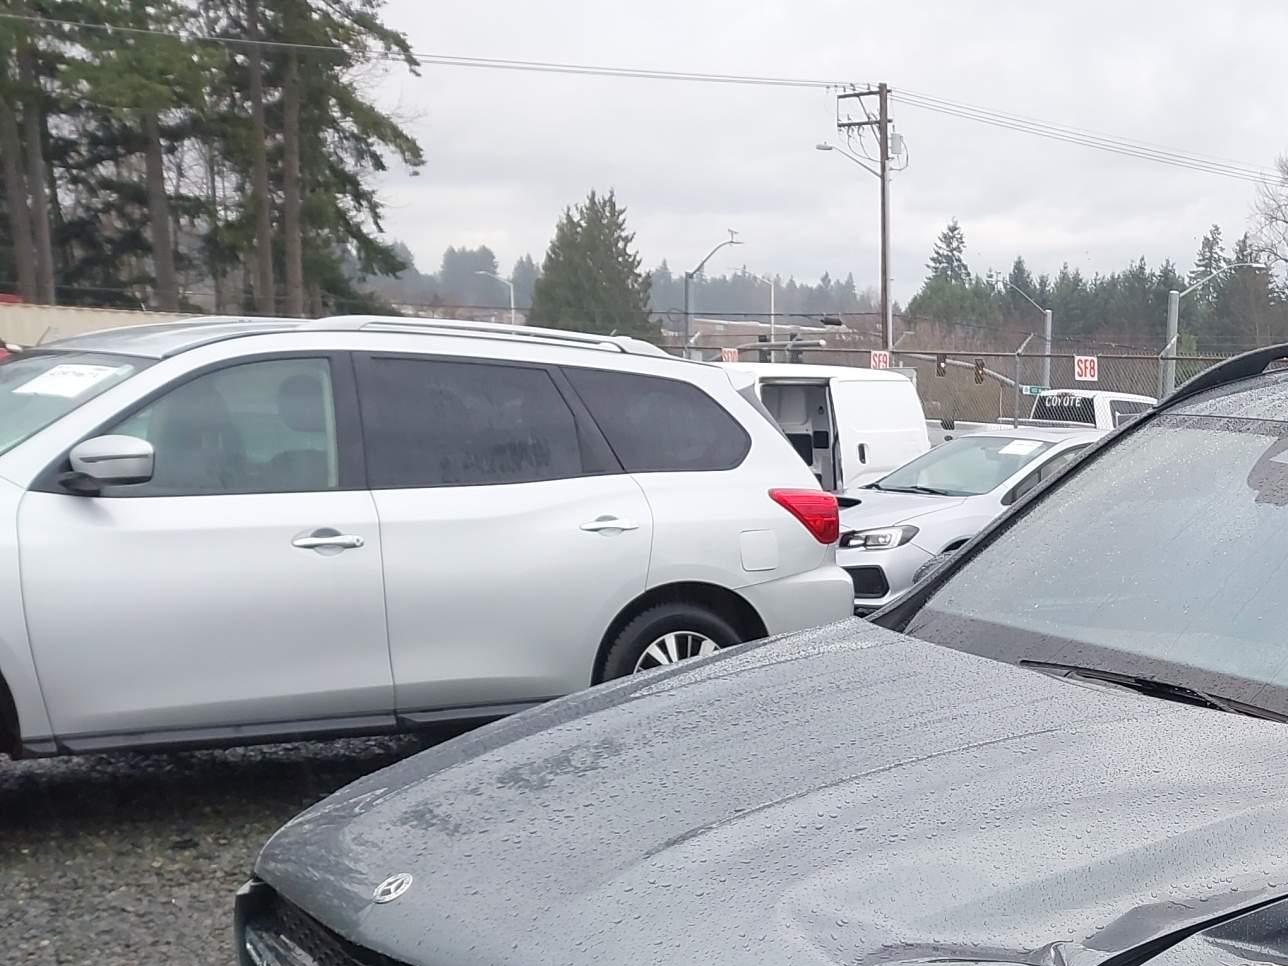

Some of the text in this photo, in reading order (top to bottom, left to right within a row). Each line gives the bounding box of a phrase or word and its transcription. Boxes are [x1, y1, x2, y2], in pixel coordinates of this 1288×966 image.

[873, 353, 888, 369] SF9
[1077, 359, 1096, 378] SF8
[1045, 396, 1081, 407] COYOTE
